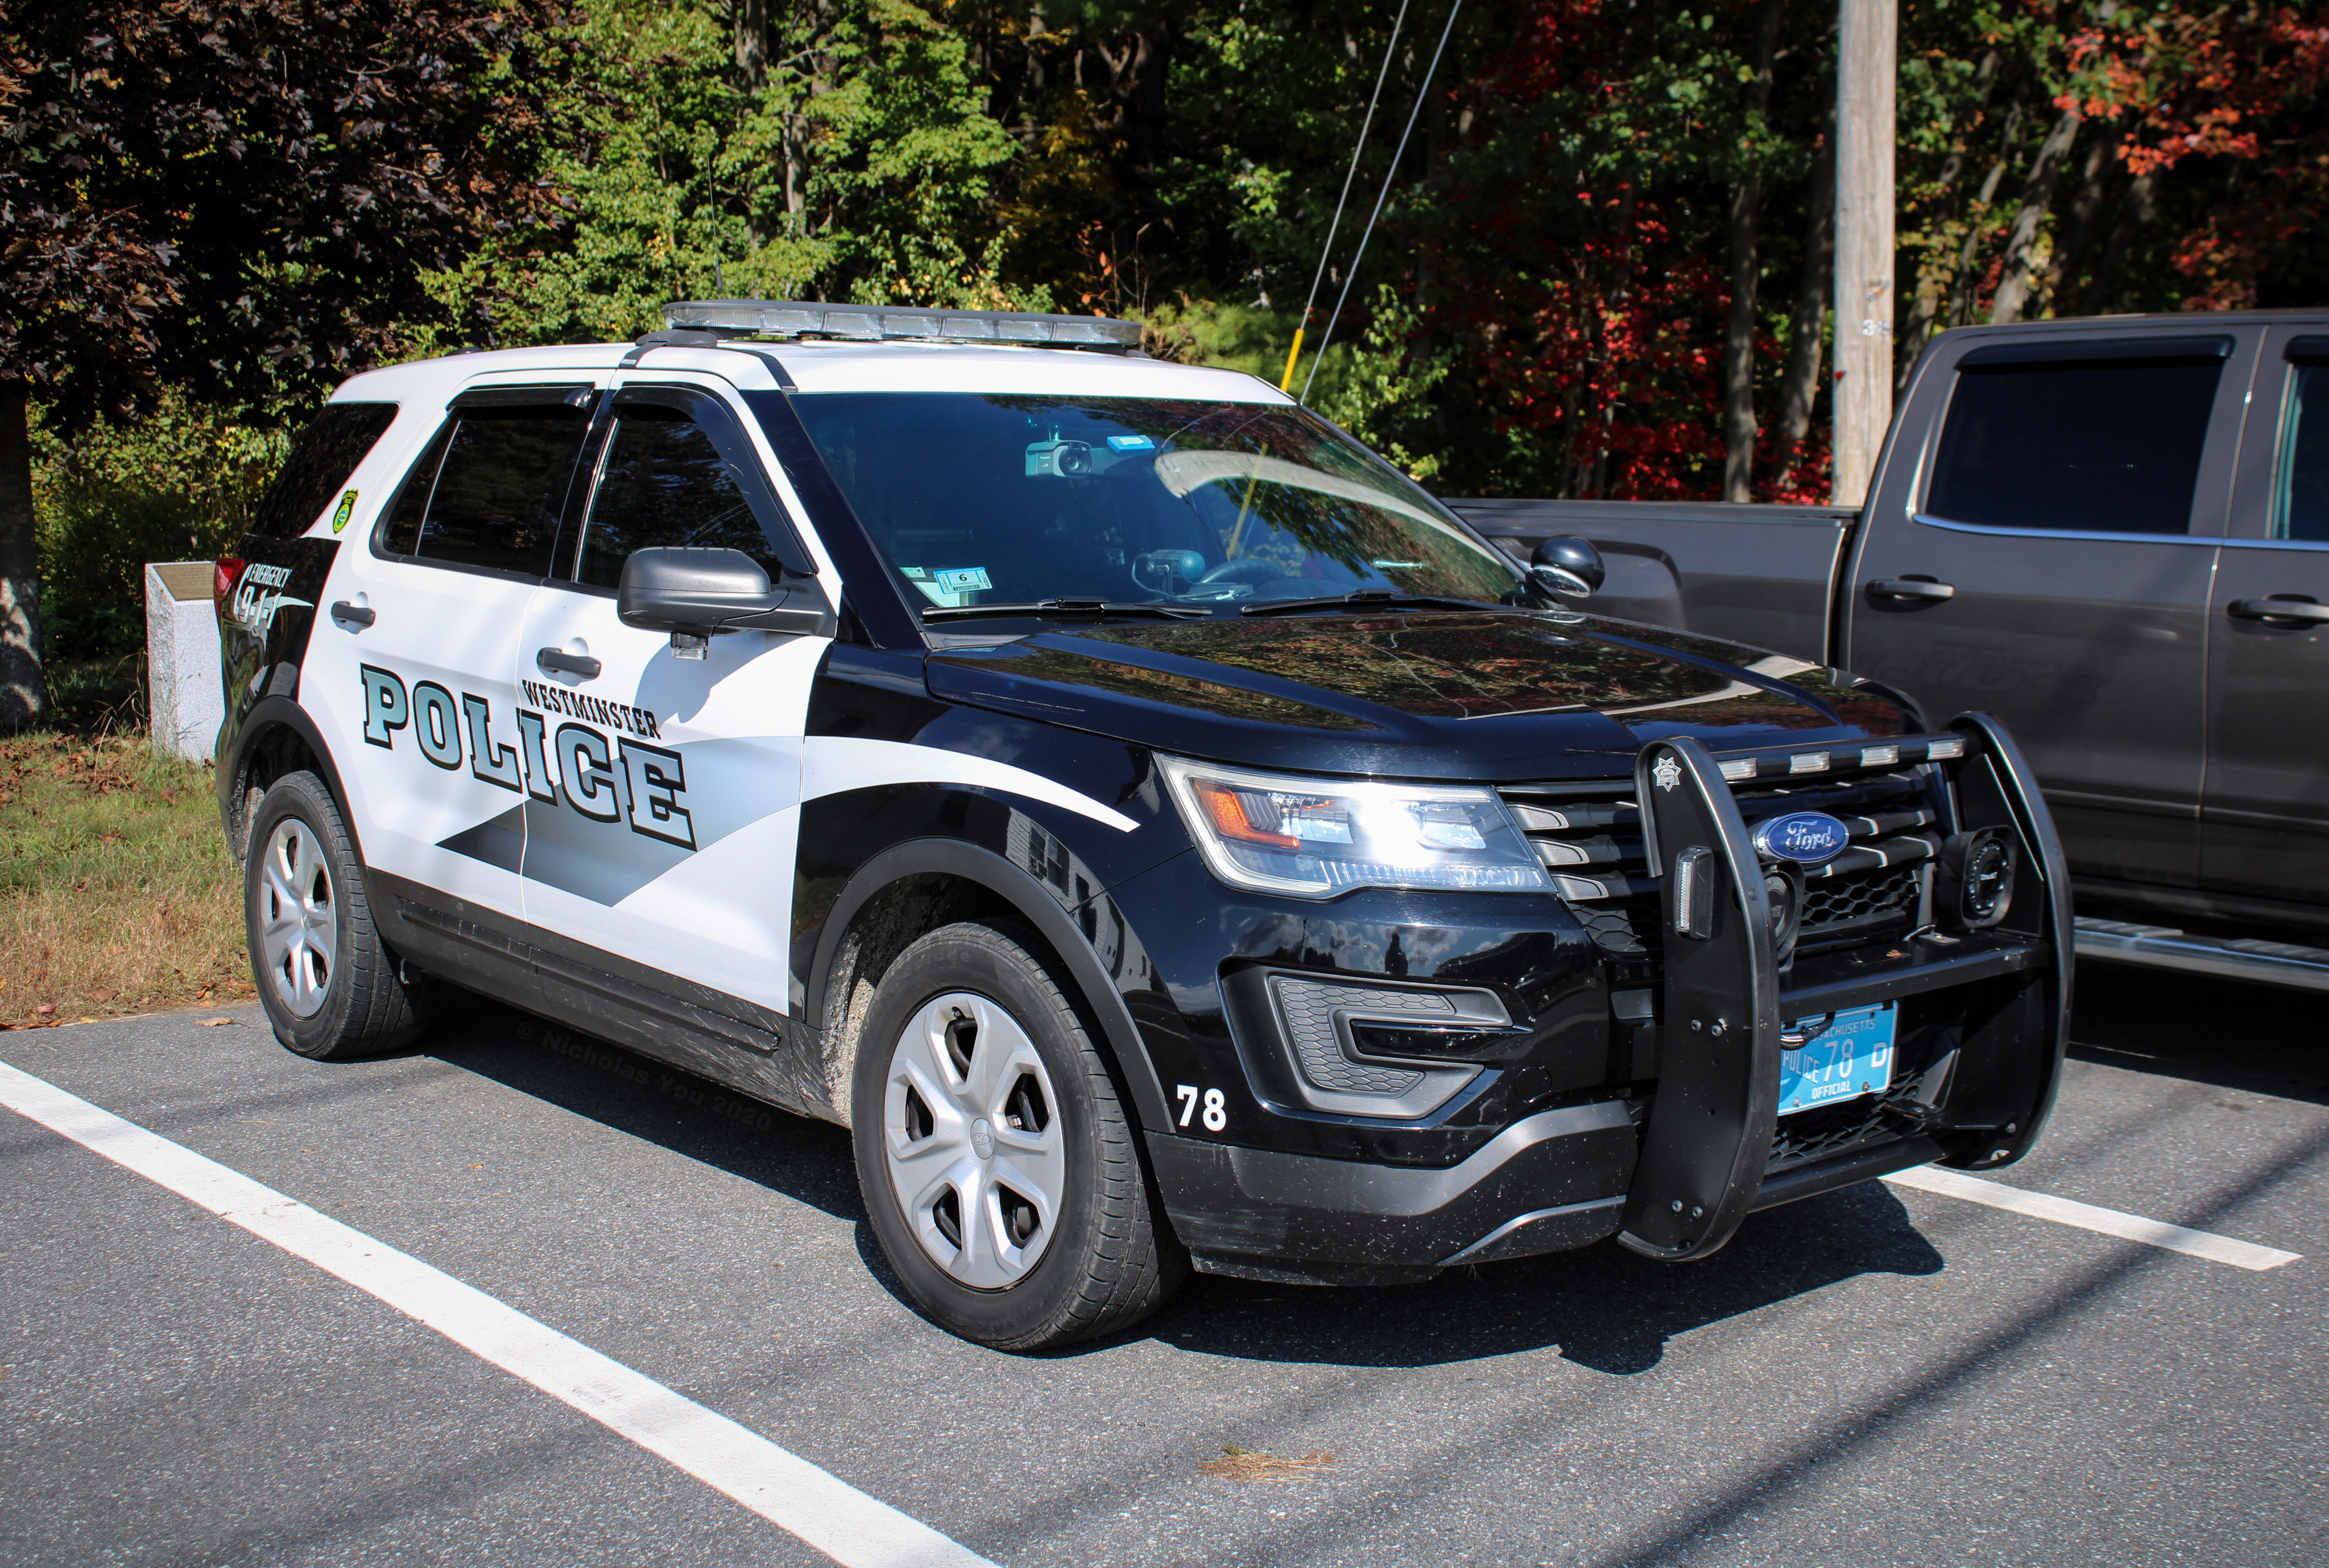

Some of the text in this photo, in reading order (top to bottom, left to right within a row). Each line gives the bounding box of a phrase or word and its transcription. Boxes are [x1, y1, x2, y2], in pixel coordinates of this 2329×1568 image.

[249, 563, 293, 588] EMERGENCY
[239, 585, 282, 630] 9-1-1
[522, 679, 661, 740] WESTMINSTER
[360, 662, 698, 853] POLICE
[1785, 820, 1837, 852] Ford
[1782, 1038, 1888, 1084] POLICE 78 D
[1177, 1083, 1227, 1132] 78
[1811, 1080, 1852, 1100] OFFICIAL
